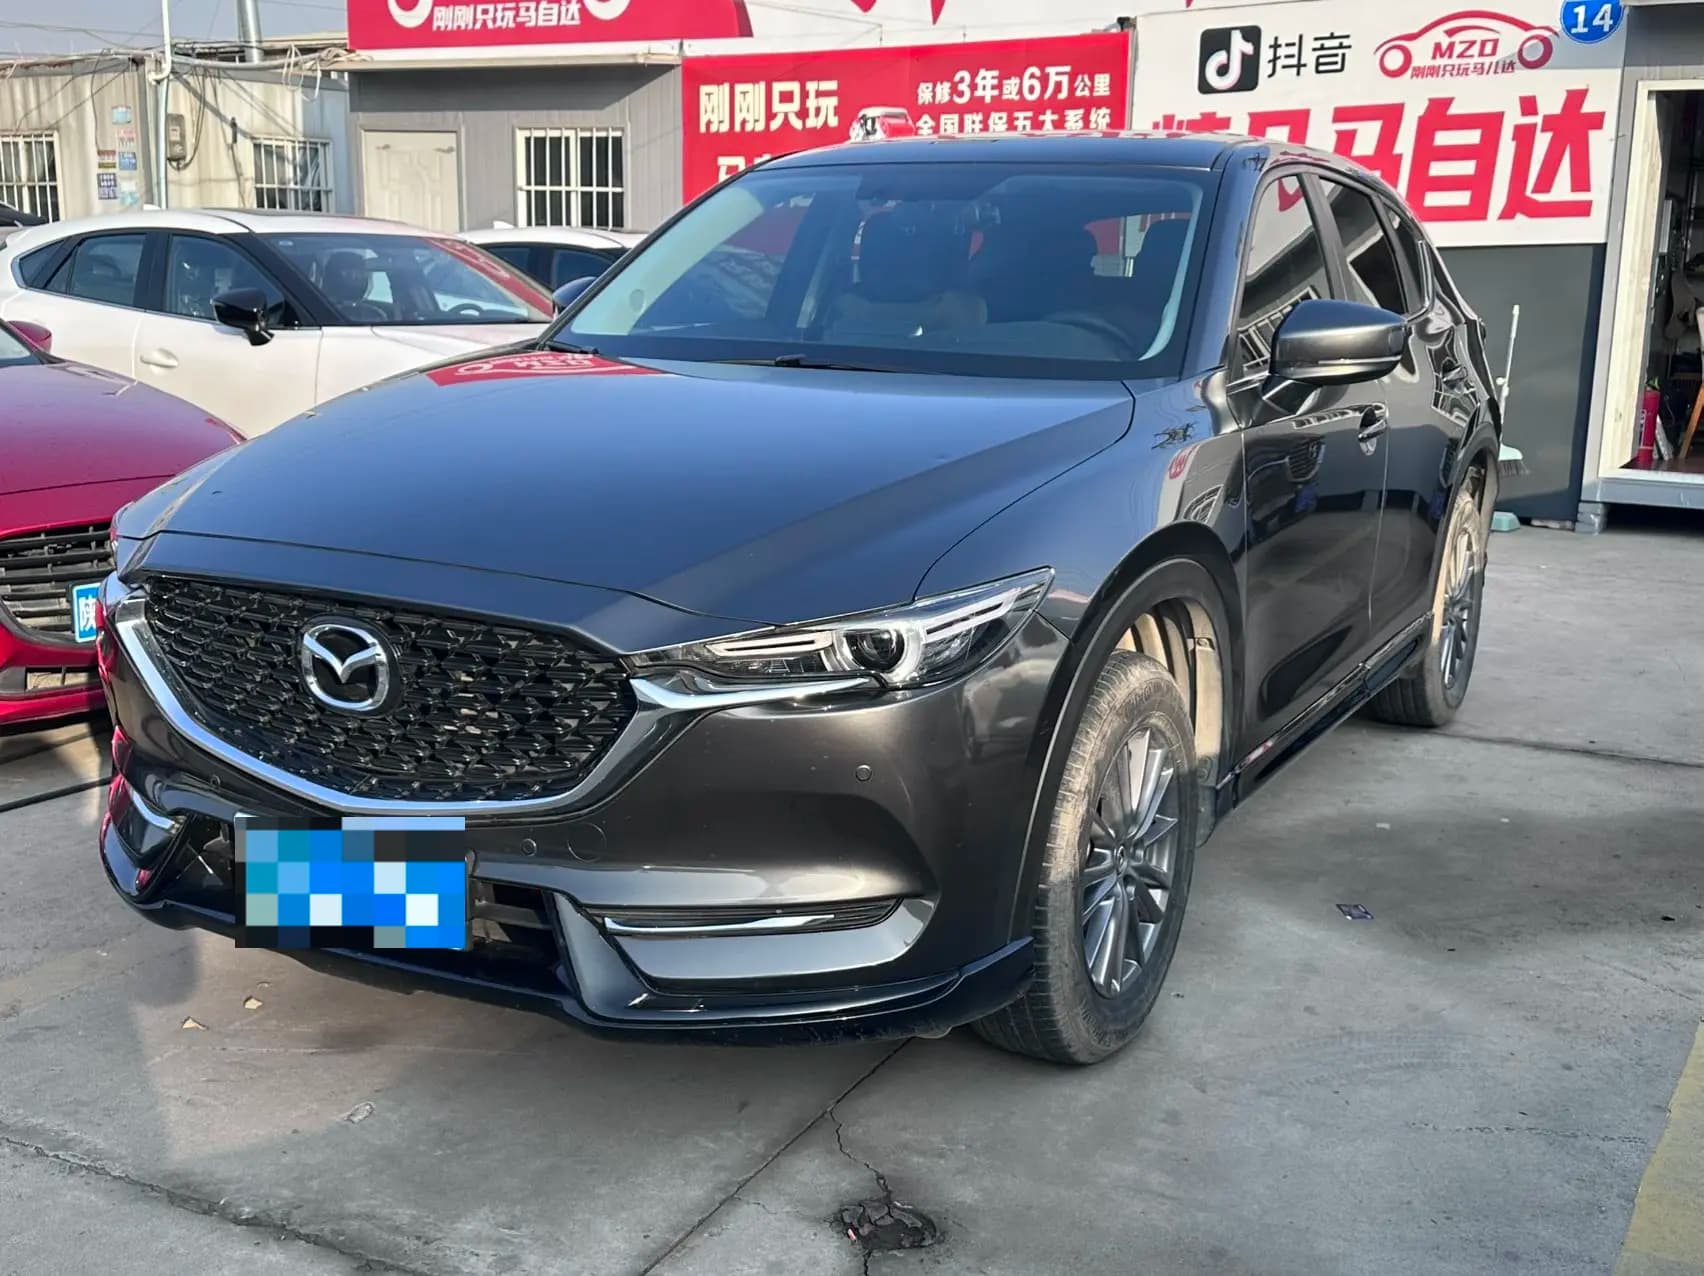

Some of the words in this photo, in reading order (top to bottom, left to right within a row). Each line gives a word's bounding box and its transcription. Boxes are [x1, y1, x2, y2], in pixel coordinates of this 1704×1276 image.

[432, 1, 582, 31] 刚刚只玩马自达
[1571, 3, 1614, 34] 14
[1267, 31, 1353, 79] 抖音
[699, 80, 839, 133] 刚刚只玩
[916, 107, 1111, 136] 全国联保五大系统
